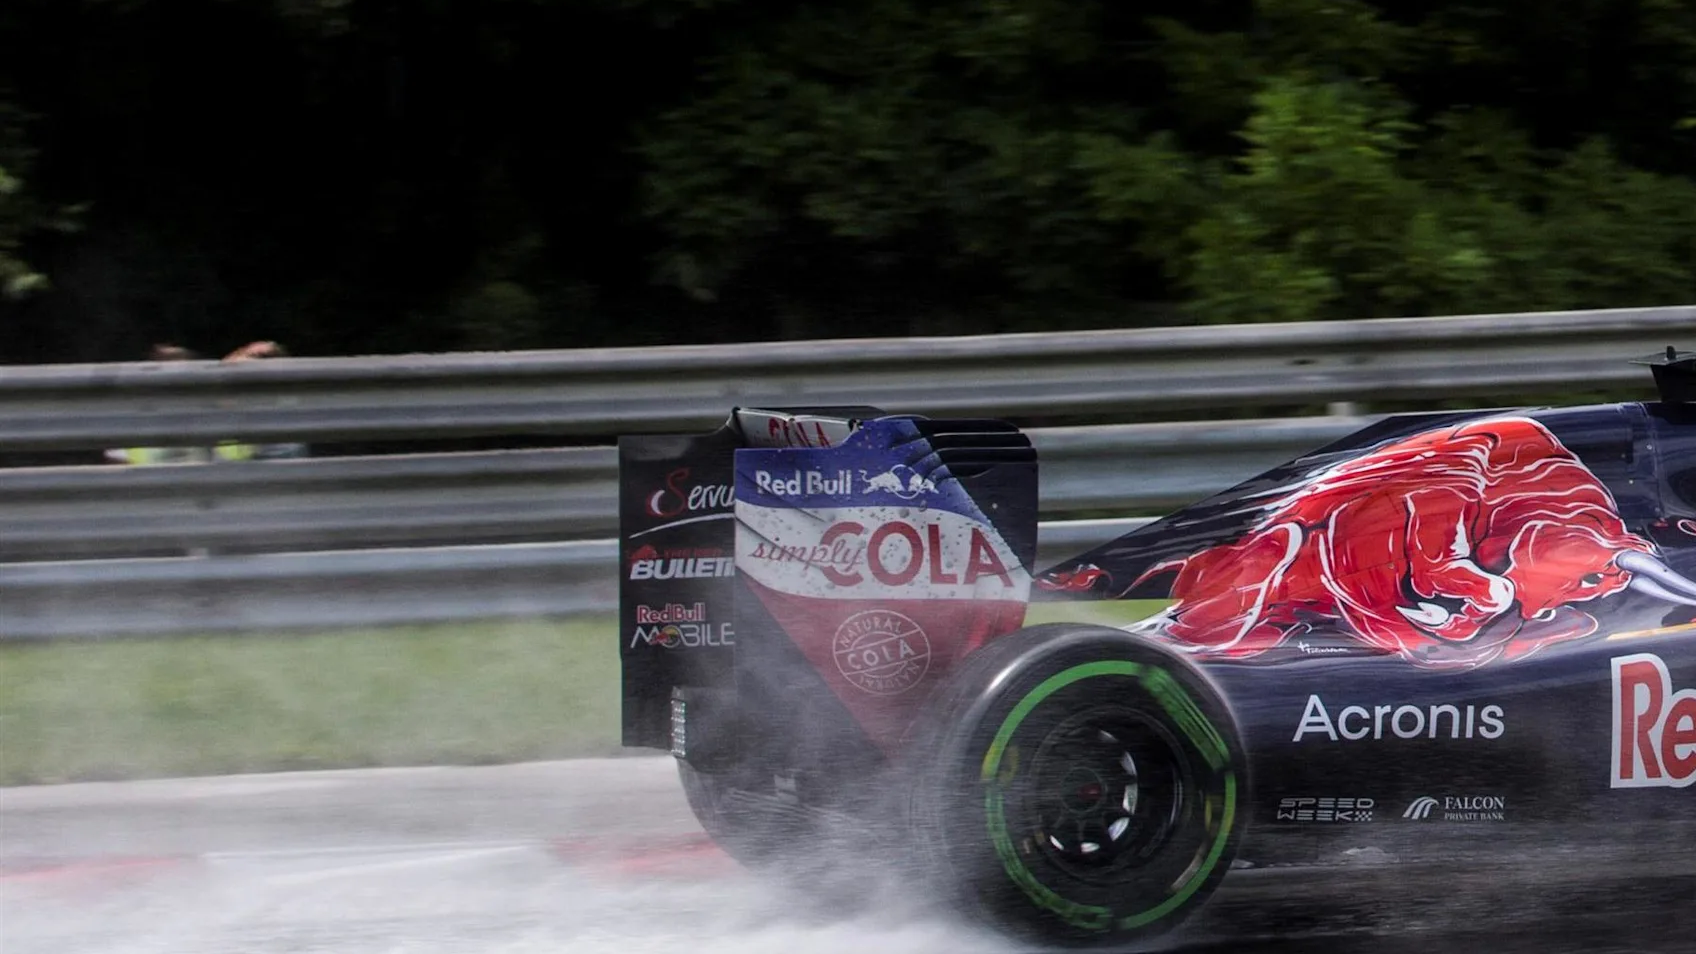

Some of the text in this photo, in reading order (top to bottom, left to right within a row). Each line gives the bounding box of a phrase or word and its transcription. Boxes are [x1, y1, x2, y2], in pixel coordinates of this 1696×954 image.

[756, 469, 852, 496] Red Bull
[750, 538, 864, 573] simply
[819, 520, 1015, 588] COLA
[637, 602, 706, 623] Red Bull
[630, 623, 735, 648] MOBILE
[840, 616, 903, 648] NATURAL
[847, 639, 916, 670] COLA
[1292, 694, 1505, 742] Acronis
[1277, 809, 1354, 821] WEEK
[1279, 797, 1374, 808] SPEED
[1444, 796, 1505, 810] FALCON
[1444, 812, 1504, 821] PRIVATE BANK
